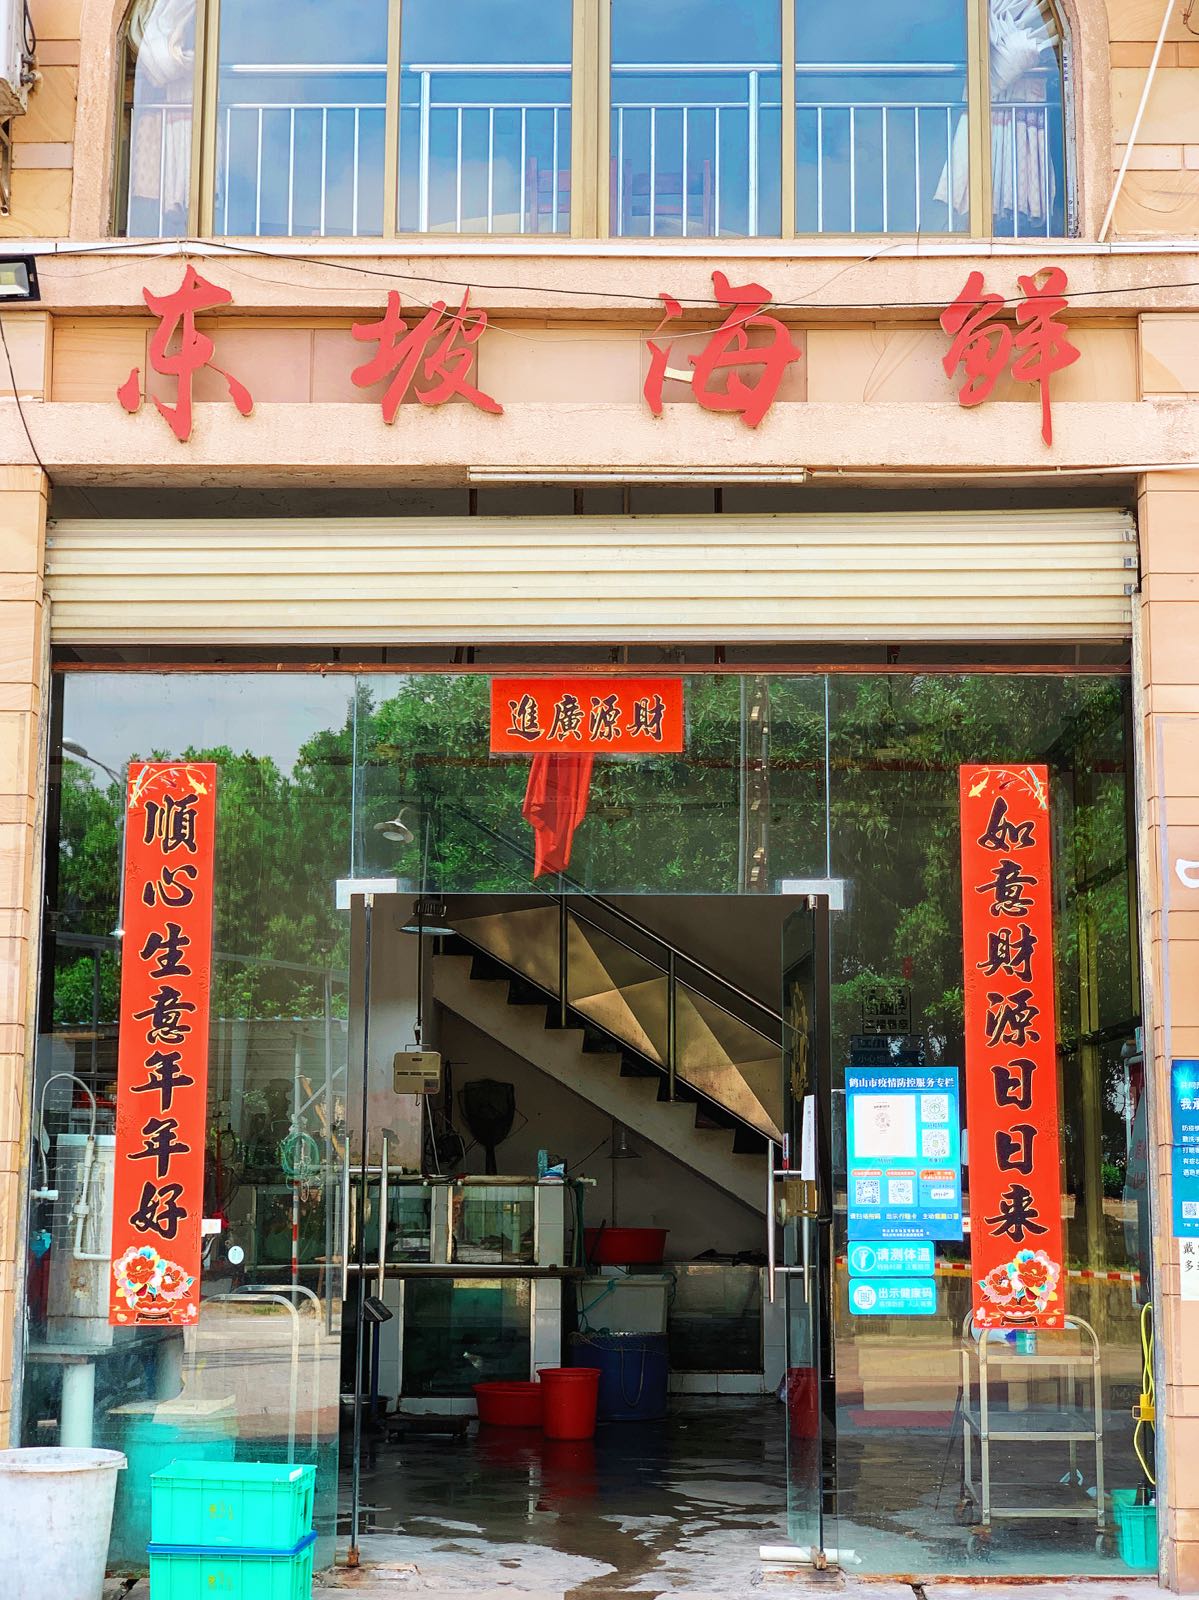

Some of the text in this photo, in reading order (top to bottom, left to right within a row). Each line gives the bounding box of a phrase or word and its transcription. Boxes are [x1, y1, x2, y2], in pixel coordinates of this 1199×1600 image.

[117, 264, 1081, 448] 东坡海鲜
[126, 794, 202, 1241] 順心生意年年好
[849, 1077, 955, 1089] 鹤山市疫情防控服务专栏
[876, 1248, 931, 1262] 请测体温
[878, 1288, 933, 1299] 出示健康码
